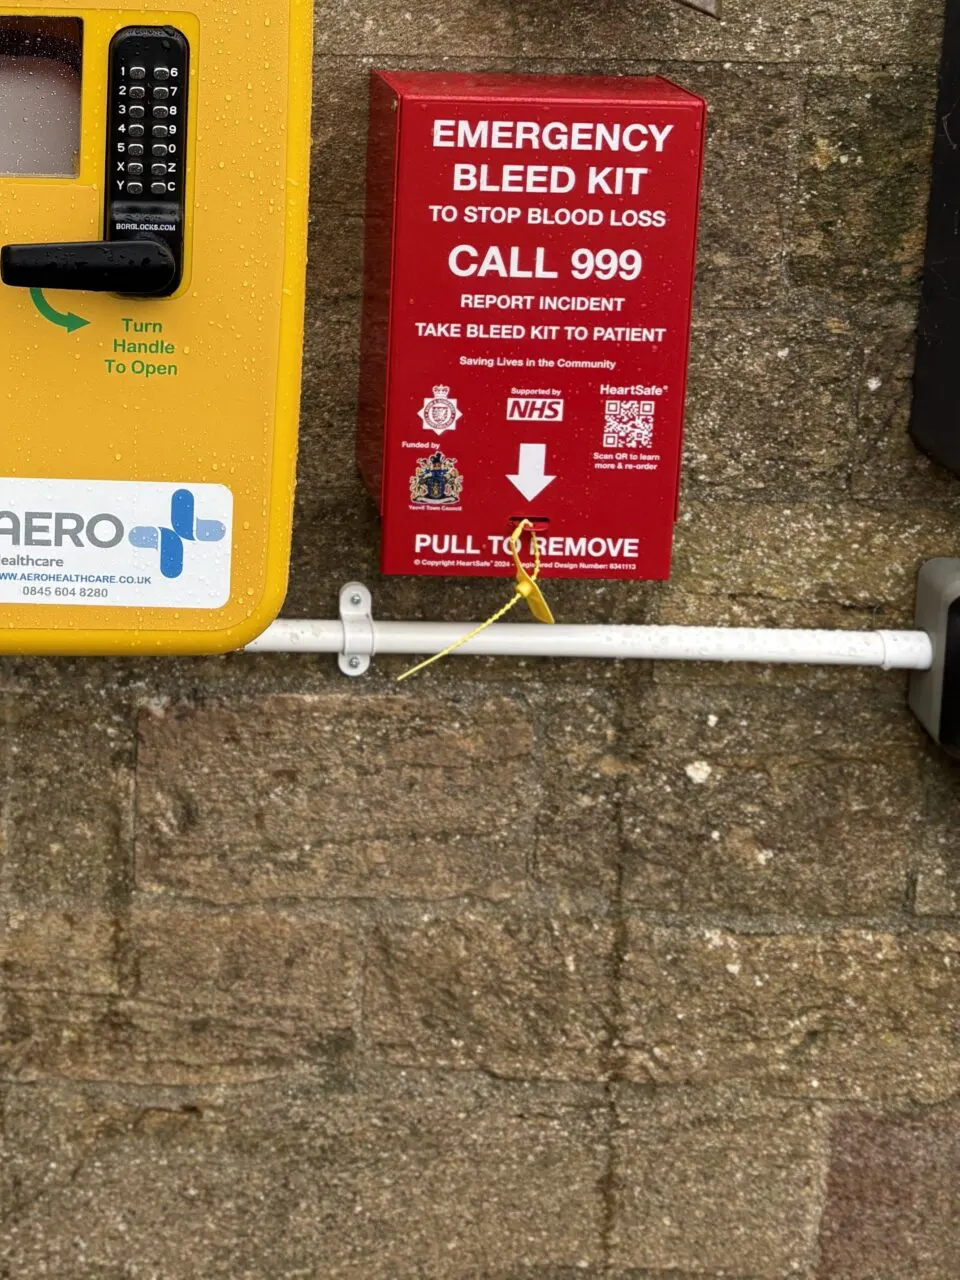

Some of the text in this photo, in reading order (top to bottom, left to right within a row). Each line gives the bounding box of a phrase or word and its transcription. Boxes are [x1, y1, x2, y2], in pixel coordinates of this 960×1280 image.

[121, 67, 178, 77] 1 6
[119, 87, 178, 96] 2 7
[118, 105, 177, 115] 3 8
[118, 124, 176, 134] 4 9
[432, 119, 674, 153] EMERGENCY
[117, 143, 176, 153] 5 0
[117, 162, 176, 172] X Z
[116, 180, 175, 191] Y C
[453, 164, 648, 195] BLEED KIT
[429, 206, 666, 227] TO STOP BLOOD LOSS
[116, 223, 176, 231] BORGLOCKS.COM
[447, 244, 643, 281] CALL 999
[460, 294, 625, 312] REPORT INCIDENT
[121, 319, 163, 333] Turn
[415, 322, 667, 343] TAKE BLEED KIT TO PATIENT
[113, 339, 175, 354] Handle
[105, 360, 177, 377] To Open
[459, 356, 616, 372] Saving Lives in the Community
[509, 401, 561, 419] NHS
[593, 452, 613, 460] Scan
[414, 534, 639, 557] PULL TO REMOVE
[421, 559, 455, 567] Copyright
[554, 562, 577, 570] Design
[579, 562, 608, 570] Number:
[23, 587, 108, 598] 0845 604 8280
